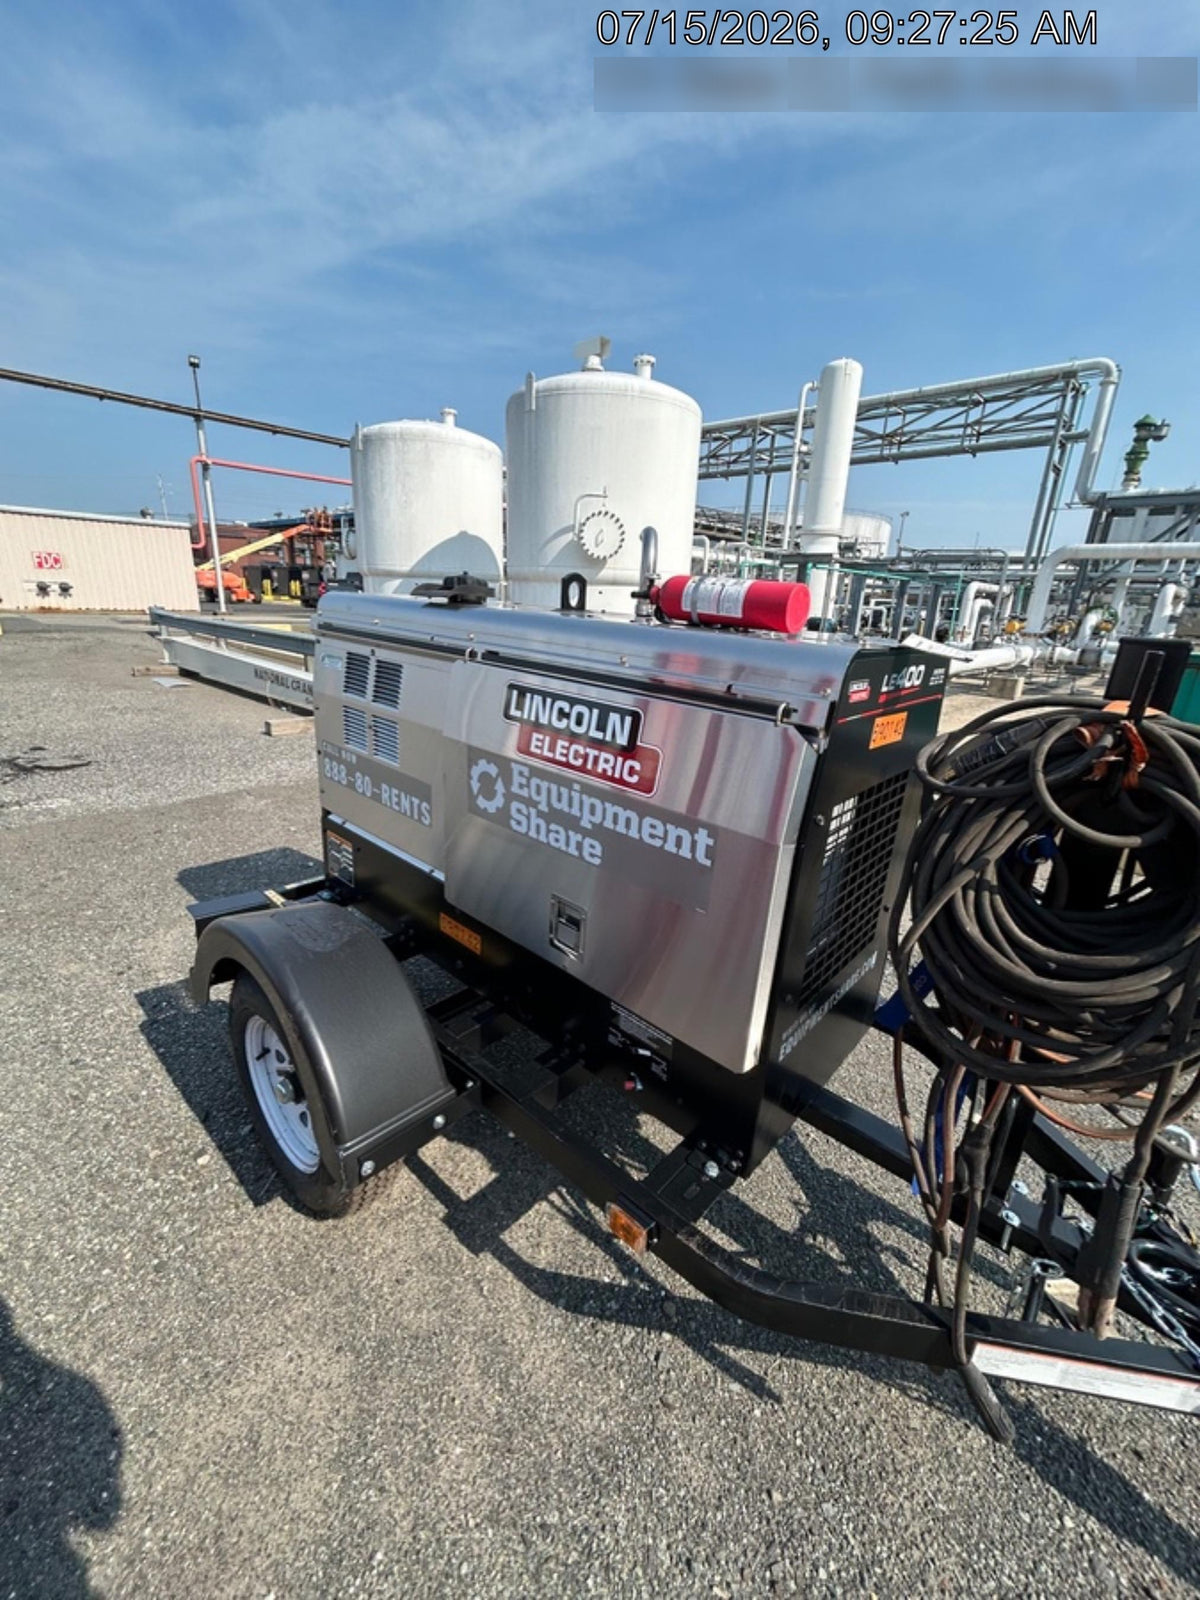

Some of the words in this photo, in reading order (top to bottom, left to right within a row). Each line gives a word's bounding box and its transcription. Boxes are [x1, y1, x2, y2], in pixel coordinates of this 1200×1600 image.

[32, 551, 63, 569] FDC
[253, 667, 290, 689] NATIONAL
[291, 680, 313, 697] CRAN
[508, 688, 634, 747] LINCOLN
[528, 731, 643, 785] ELECTRIC
[323, 757, 432, 827] 888-80-RENTS
[510, 761, 715, 868] Equipment
[509, 800, 603, 867] Share
